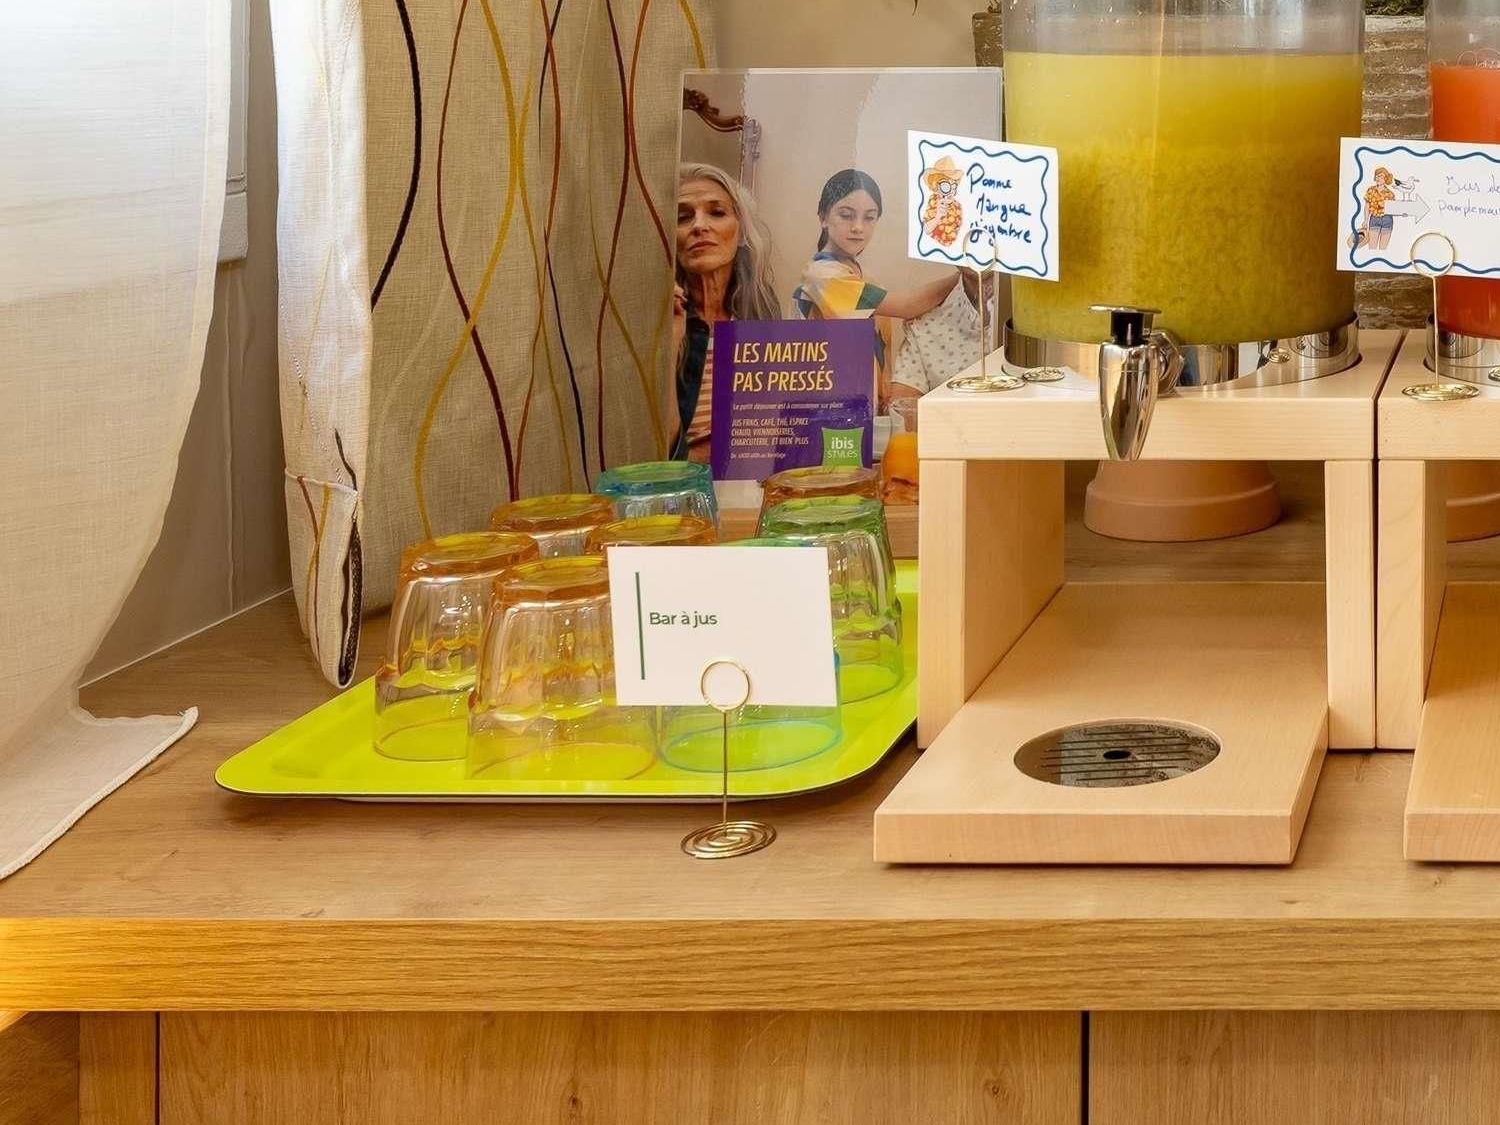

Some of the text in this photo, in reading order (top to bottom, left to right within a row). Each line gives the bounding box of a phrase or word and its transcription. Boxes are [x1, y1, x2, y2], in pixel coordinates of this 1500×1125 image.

[1446, 174, 1481, 195] Jus
[734, 341, 829, 364] LES MATINS
[733, 365, 834, 392] PAS PRESSÉS
[831, 437, 854, 450] ibis
[649, 610, 718, 628] Bar à jus
